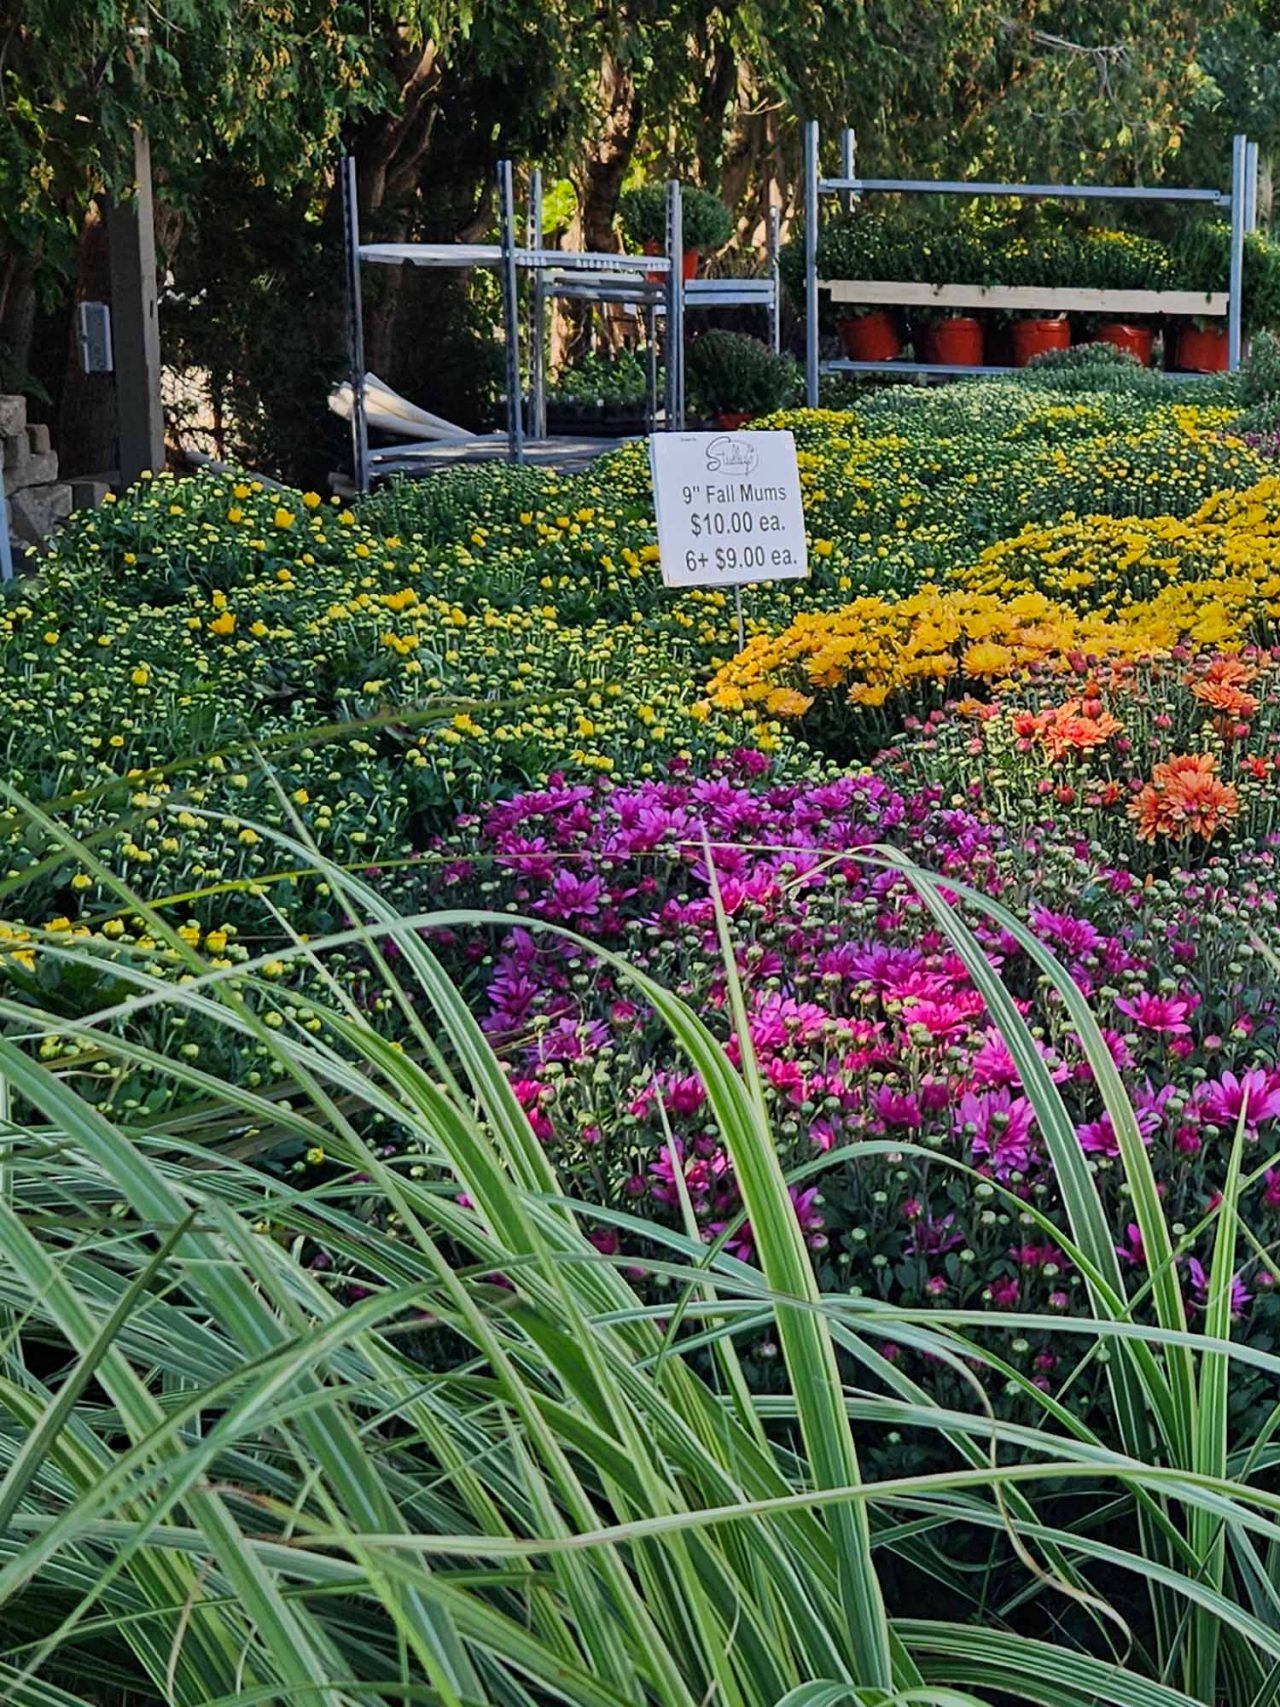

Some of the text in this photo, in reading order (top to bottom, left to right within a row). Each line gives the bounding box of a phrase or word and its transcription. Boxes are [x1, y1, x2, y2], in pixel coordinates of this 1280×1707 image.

[682, 483, 787, 505] 9" Fall Mums
[690, 511, 786, 537] $10.00 ea.
[685, 545, 798, 572] 6+ $9.00 ea.
